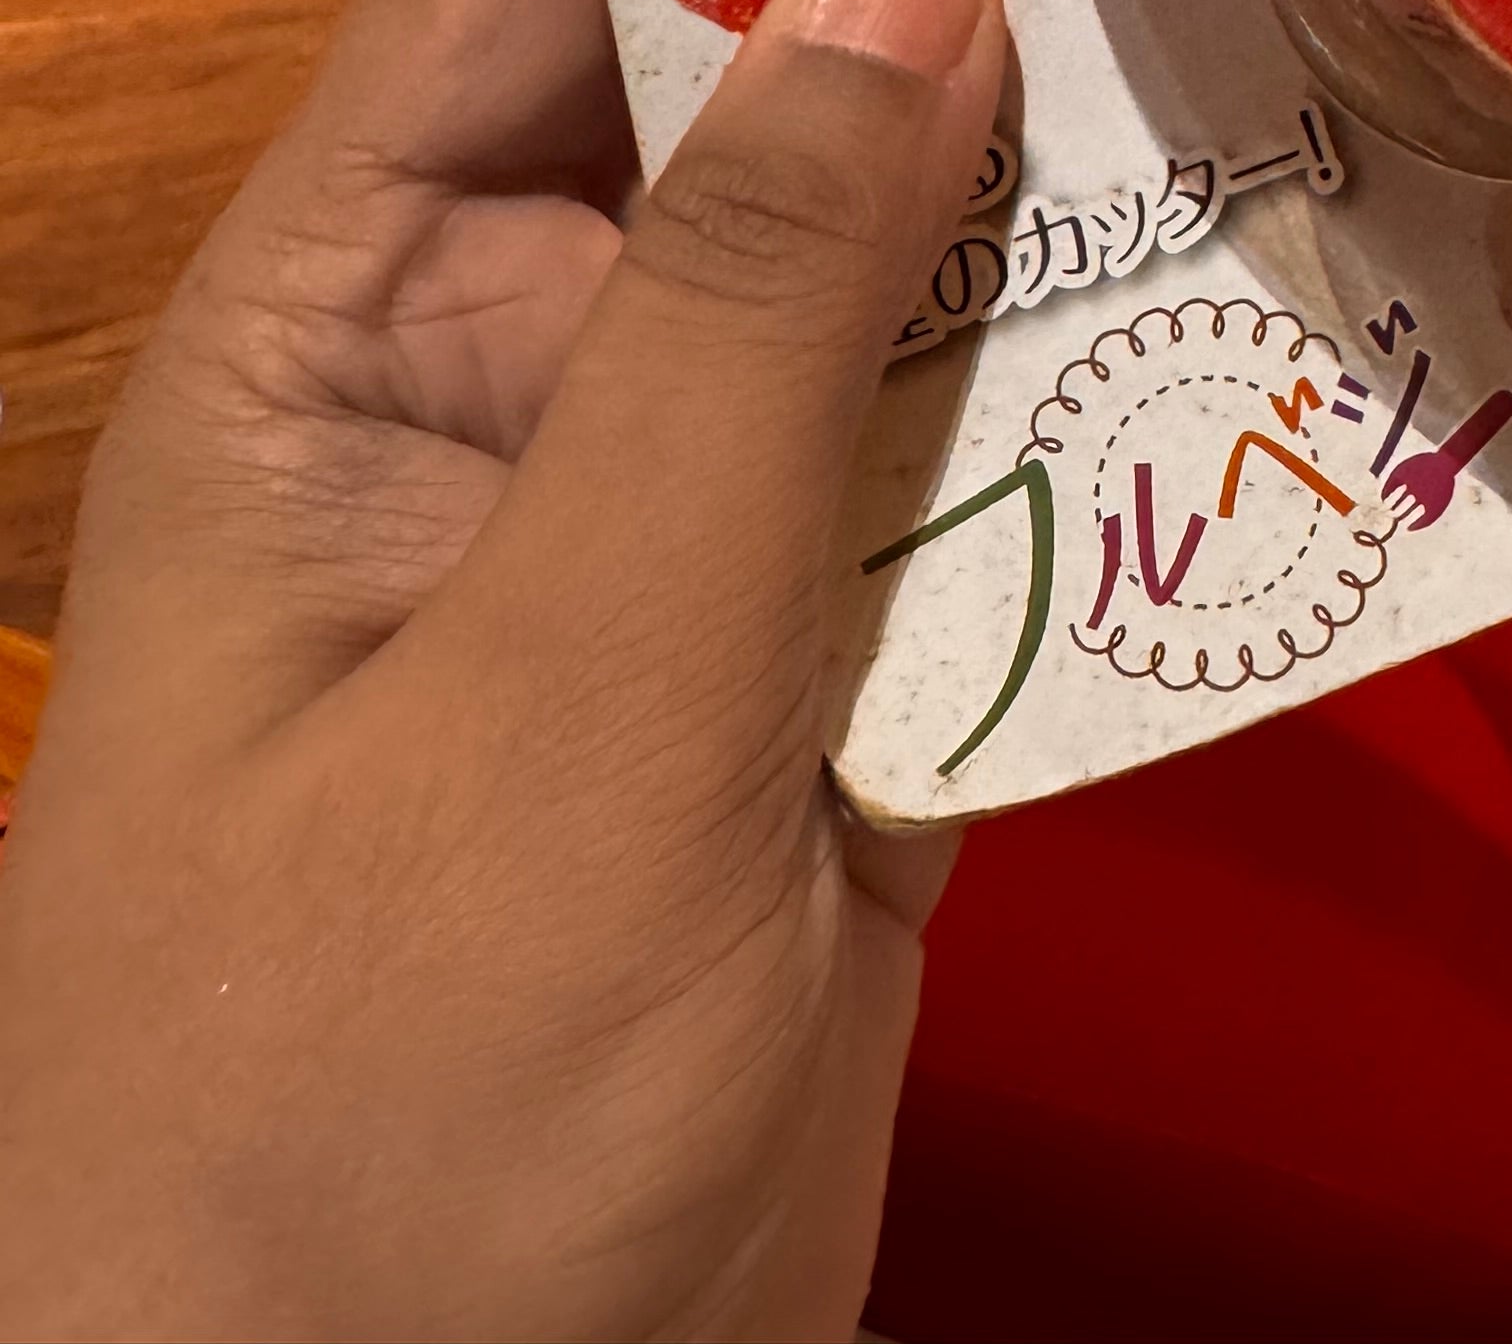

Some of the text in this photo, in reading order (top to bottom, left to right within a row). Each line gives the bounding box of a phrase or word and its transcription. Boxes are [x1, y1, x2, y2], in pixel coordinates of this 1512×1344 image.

[893, 109, 1333, 346] のカッター!
